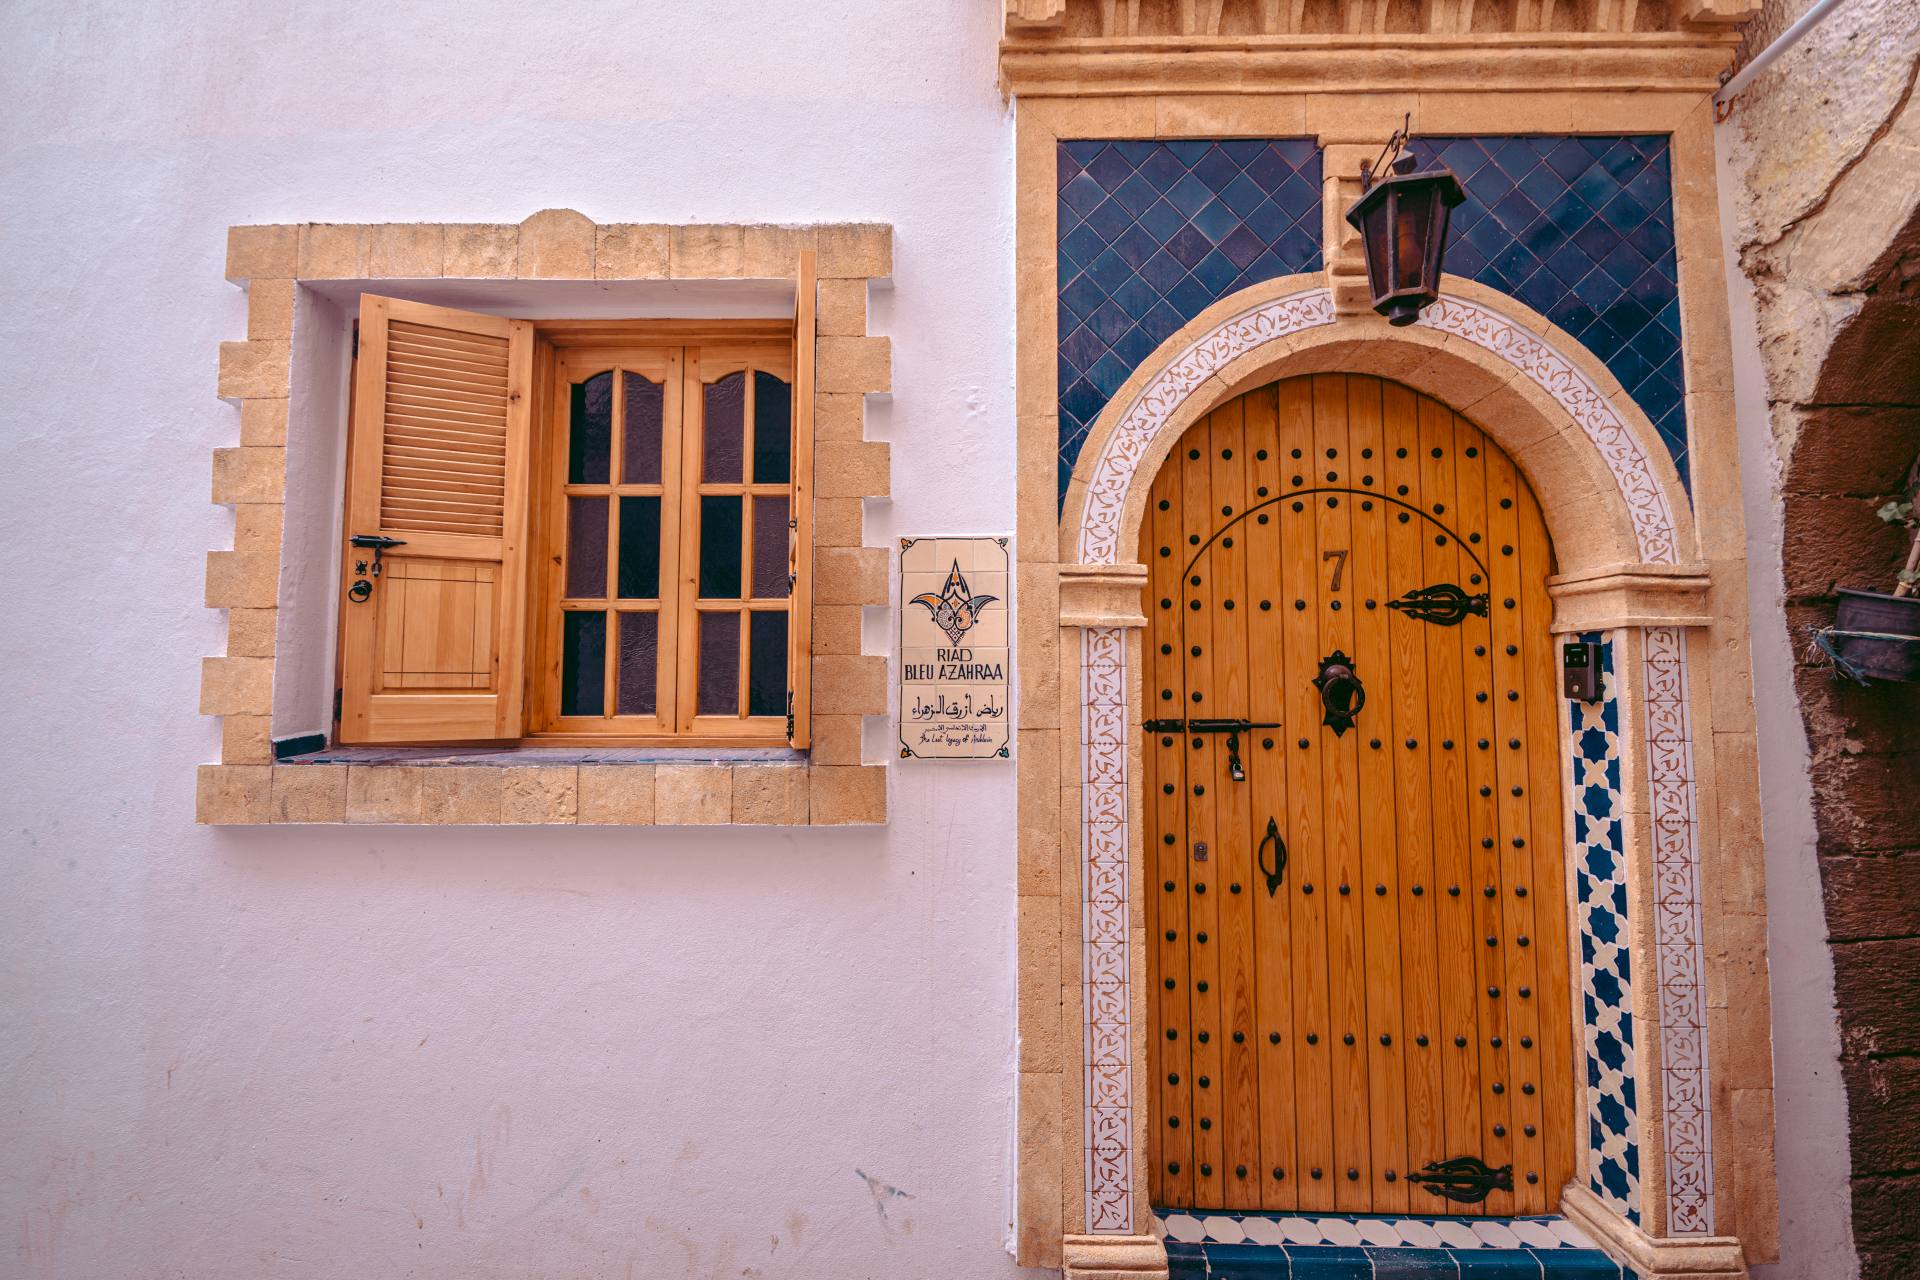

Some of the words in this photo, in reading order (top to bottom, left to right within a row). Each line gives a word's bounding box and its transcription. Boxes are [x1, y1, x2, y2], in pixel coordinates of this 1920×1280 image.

[1323, 550, 1348, 591] 7
[937, 648, 973, 662] RIAD
[904, 664, 934, 680] BLEU
[938, 663, 1003, 680] AZAHRAA
[912, 694, 945, 720] الزهراء
[945, 692, 973, 720] أزرق
[976, 694, 1004, 719] رياض
[962, 734, 970, 743] of
